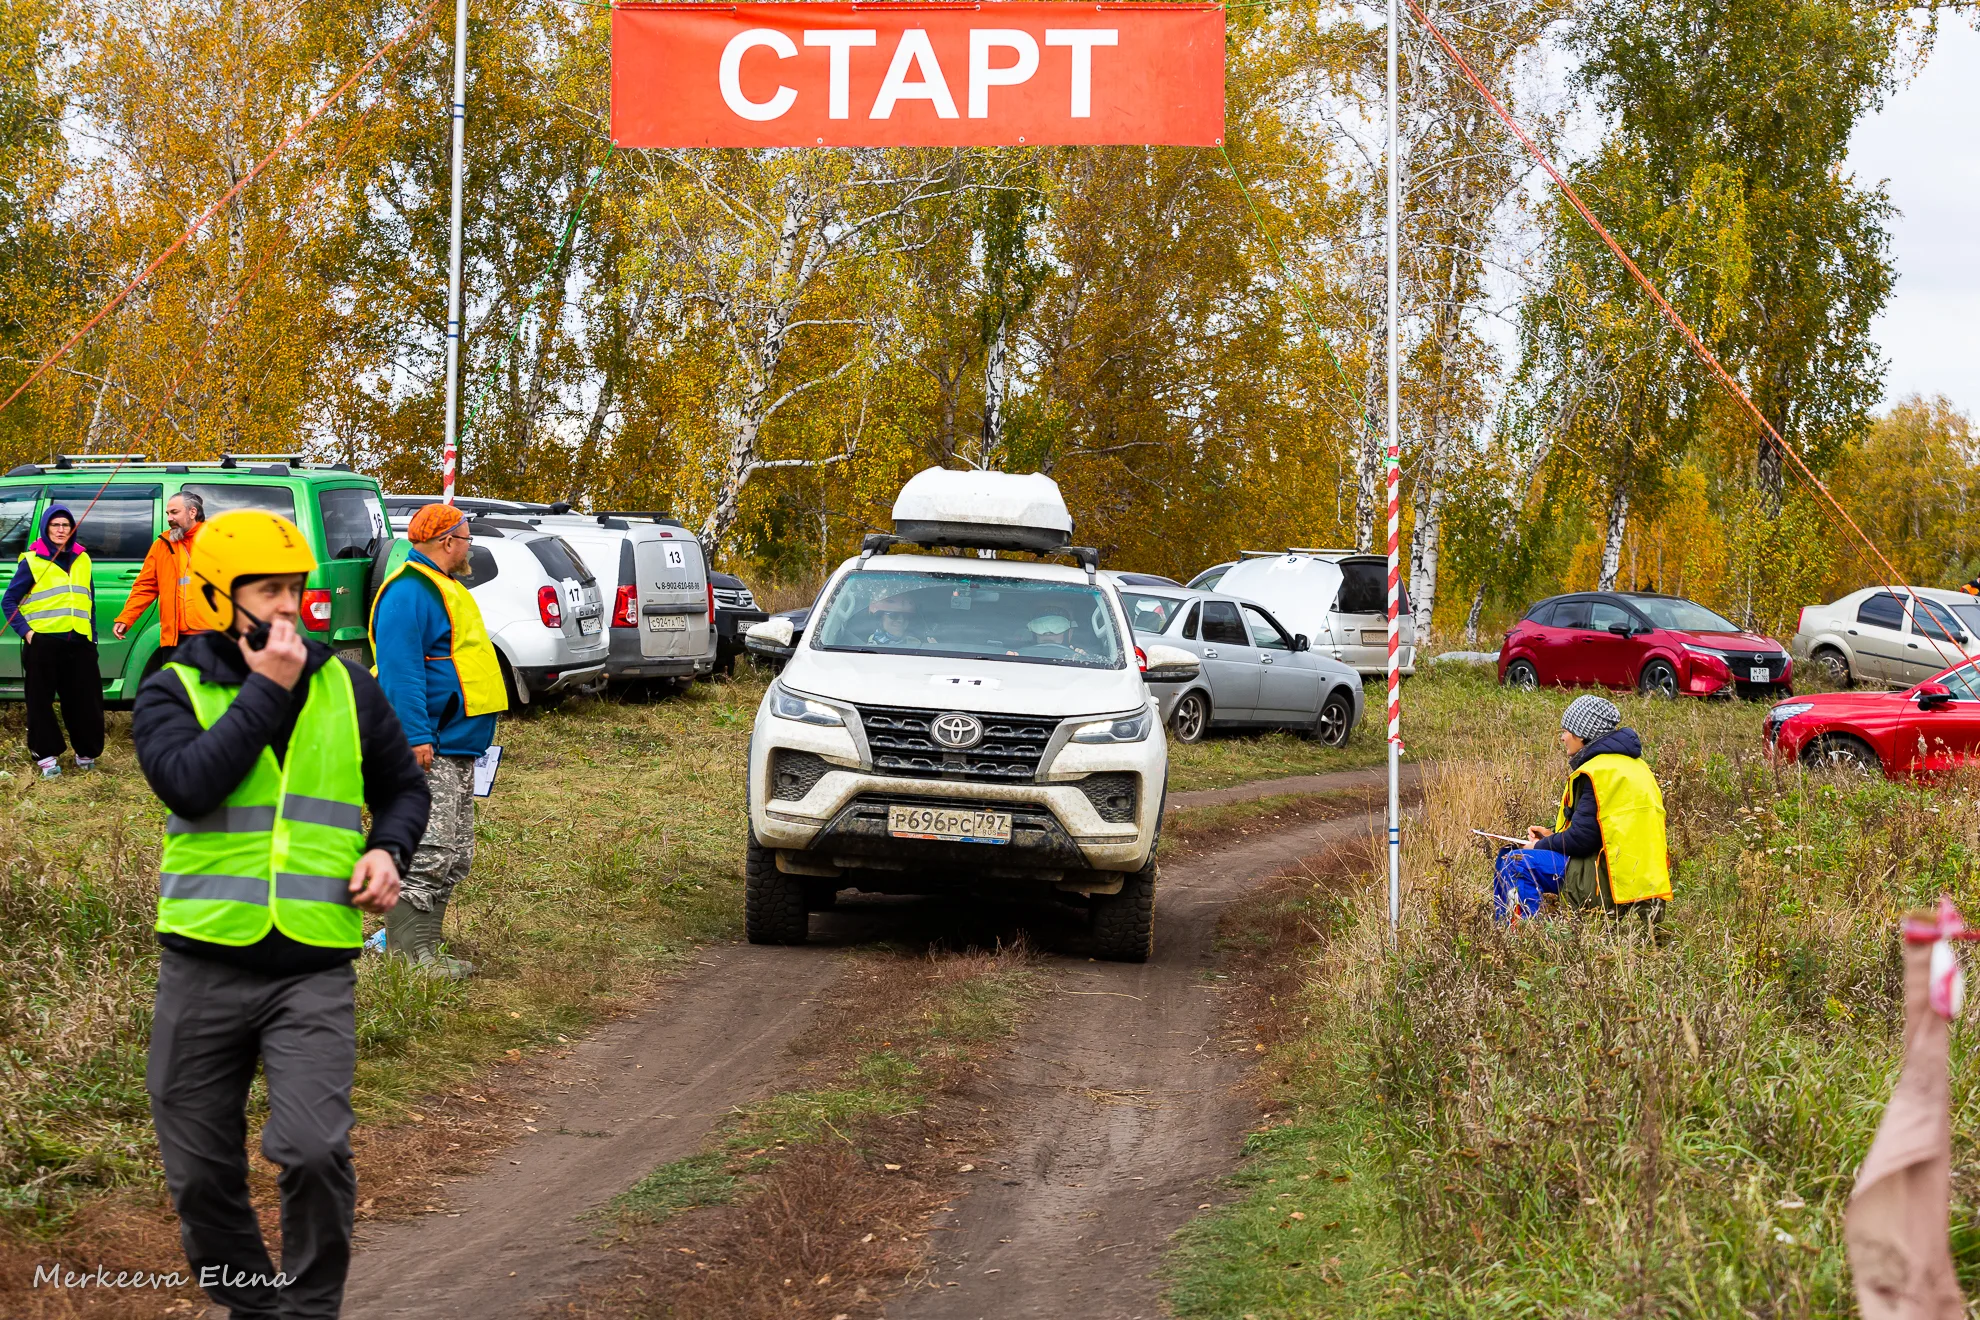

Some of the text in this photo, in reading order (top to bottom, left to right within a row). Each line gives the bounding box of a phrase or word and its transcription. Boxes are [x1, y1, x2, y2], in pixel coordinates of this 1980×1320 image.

[718, 28, 1119, 121] СТАРТ
[373, 513, 383, 529] 16
[669, 551, 682, 564] 13
[569, 588, 580, 602] 17
[976, 813, 1006, 830] 797
